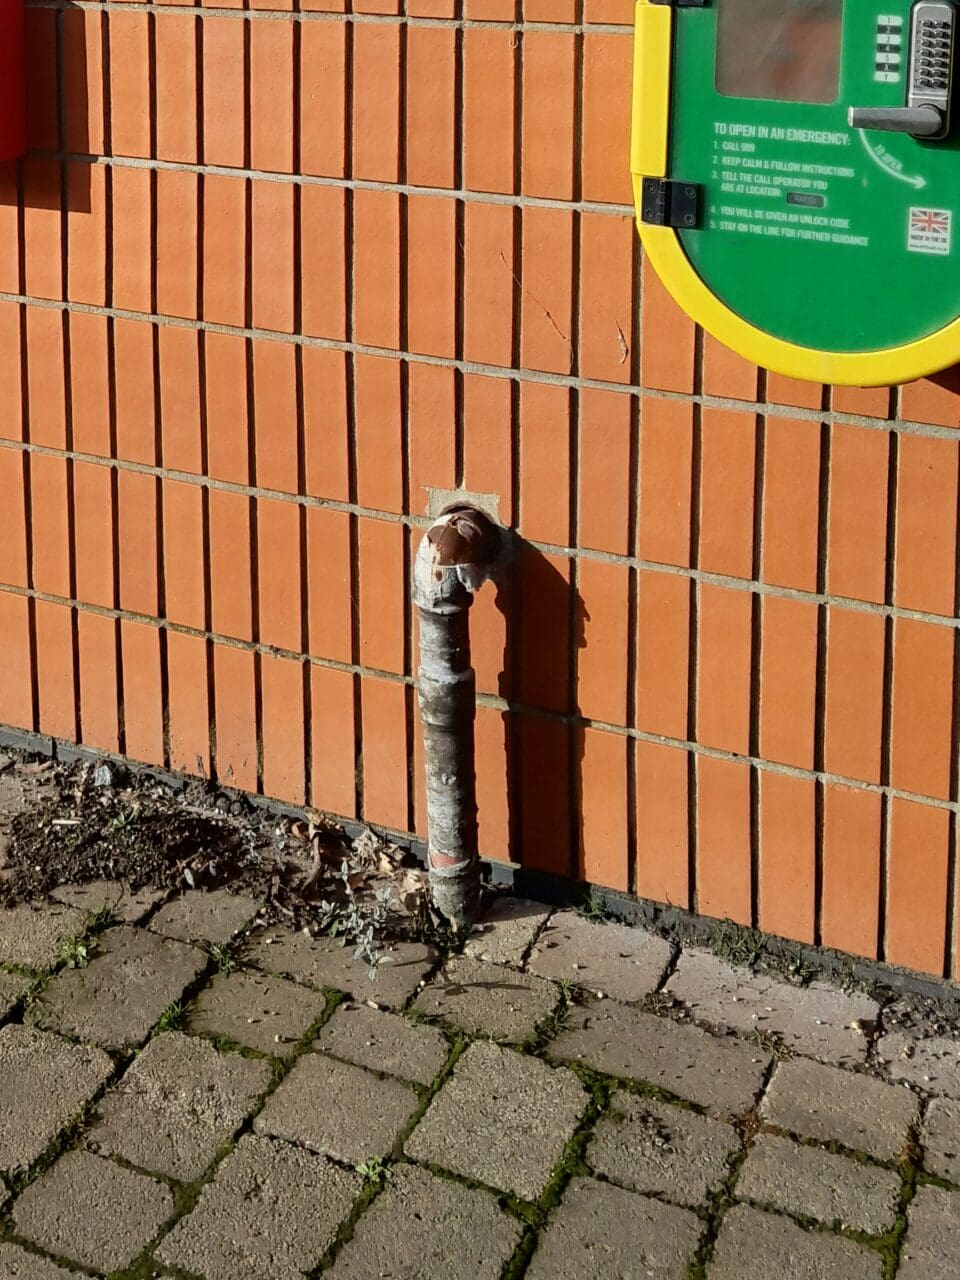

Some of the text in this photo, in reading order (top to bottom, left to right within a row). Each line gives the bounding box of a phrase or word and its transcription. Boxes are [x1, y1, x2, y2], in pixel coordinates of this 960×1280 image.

[714, 122, 851, 146] TO OPEN IN AN EMERGENCY:
[722, 142, 740, 152] CALL
[742, 143, 755, 152] 999
[722, 156, 740, 166] KEEP
[742, 158, 762, 168] CALM
[771, 160, 801, 172] FOLLOW
[802, 162, 855, 178] INSTRUCTIONS
[721, 182, 734, 192] ARE
[736, 184, 744, 194] AT
[722, 171, 738, 182] TELL
[740, 172, 753, 182] THE
[754, 174, 772, 184] CALL
[772, 176, 812, 188] OPERATOR
[812, 180, 828, 190] YOU
[720, 206, 735, 216] YOU
[736, 208, 753, 218] WILL
[754, 210, 764, 219] BE
[766, 210, 789, 222] GIVEN
[790, 212, 799, 222] AN
[800, 214, 829, 226] UNLOCK
[830, 218, 850, 229] CODE
[720, 221, 736, 232] STAY
[737, 222, 748, 232] ON
[750, 224, 762, 234] THE
[764, 226, 780, 236] LINE
[781, 227, 796, 238] FOR
[797, 229, 831, 242] FURTHER
[832, 232, 869, 247] GUIDANCE
